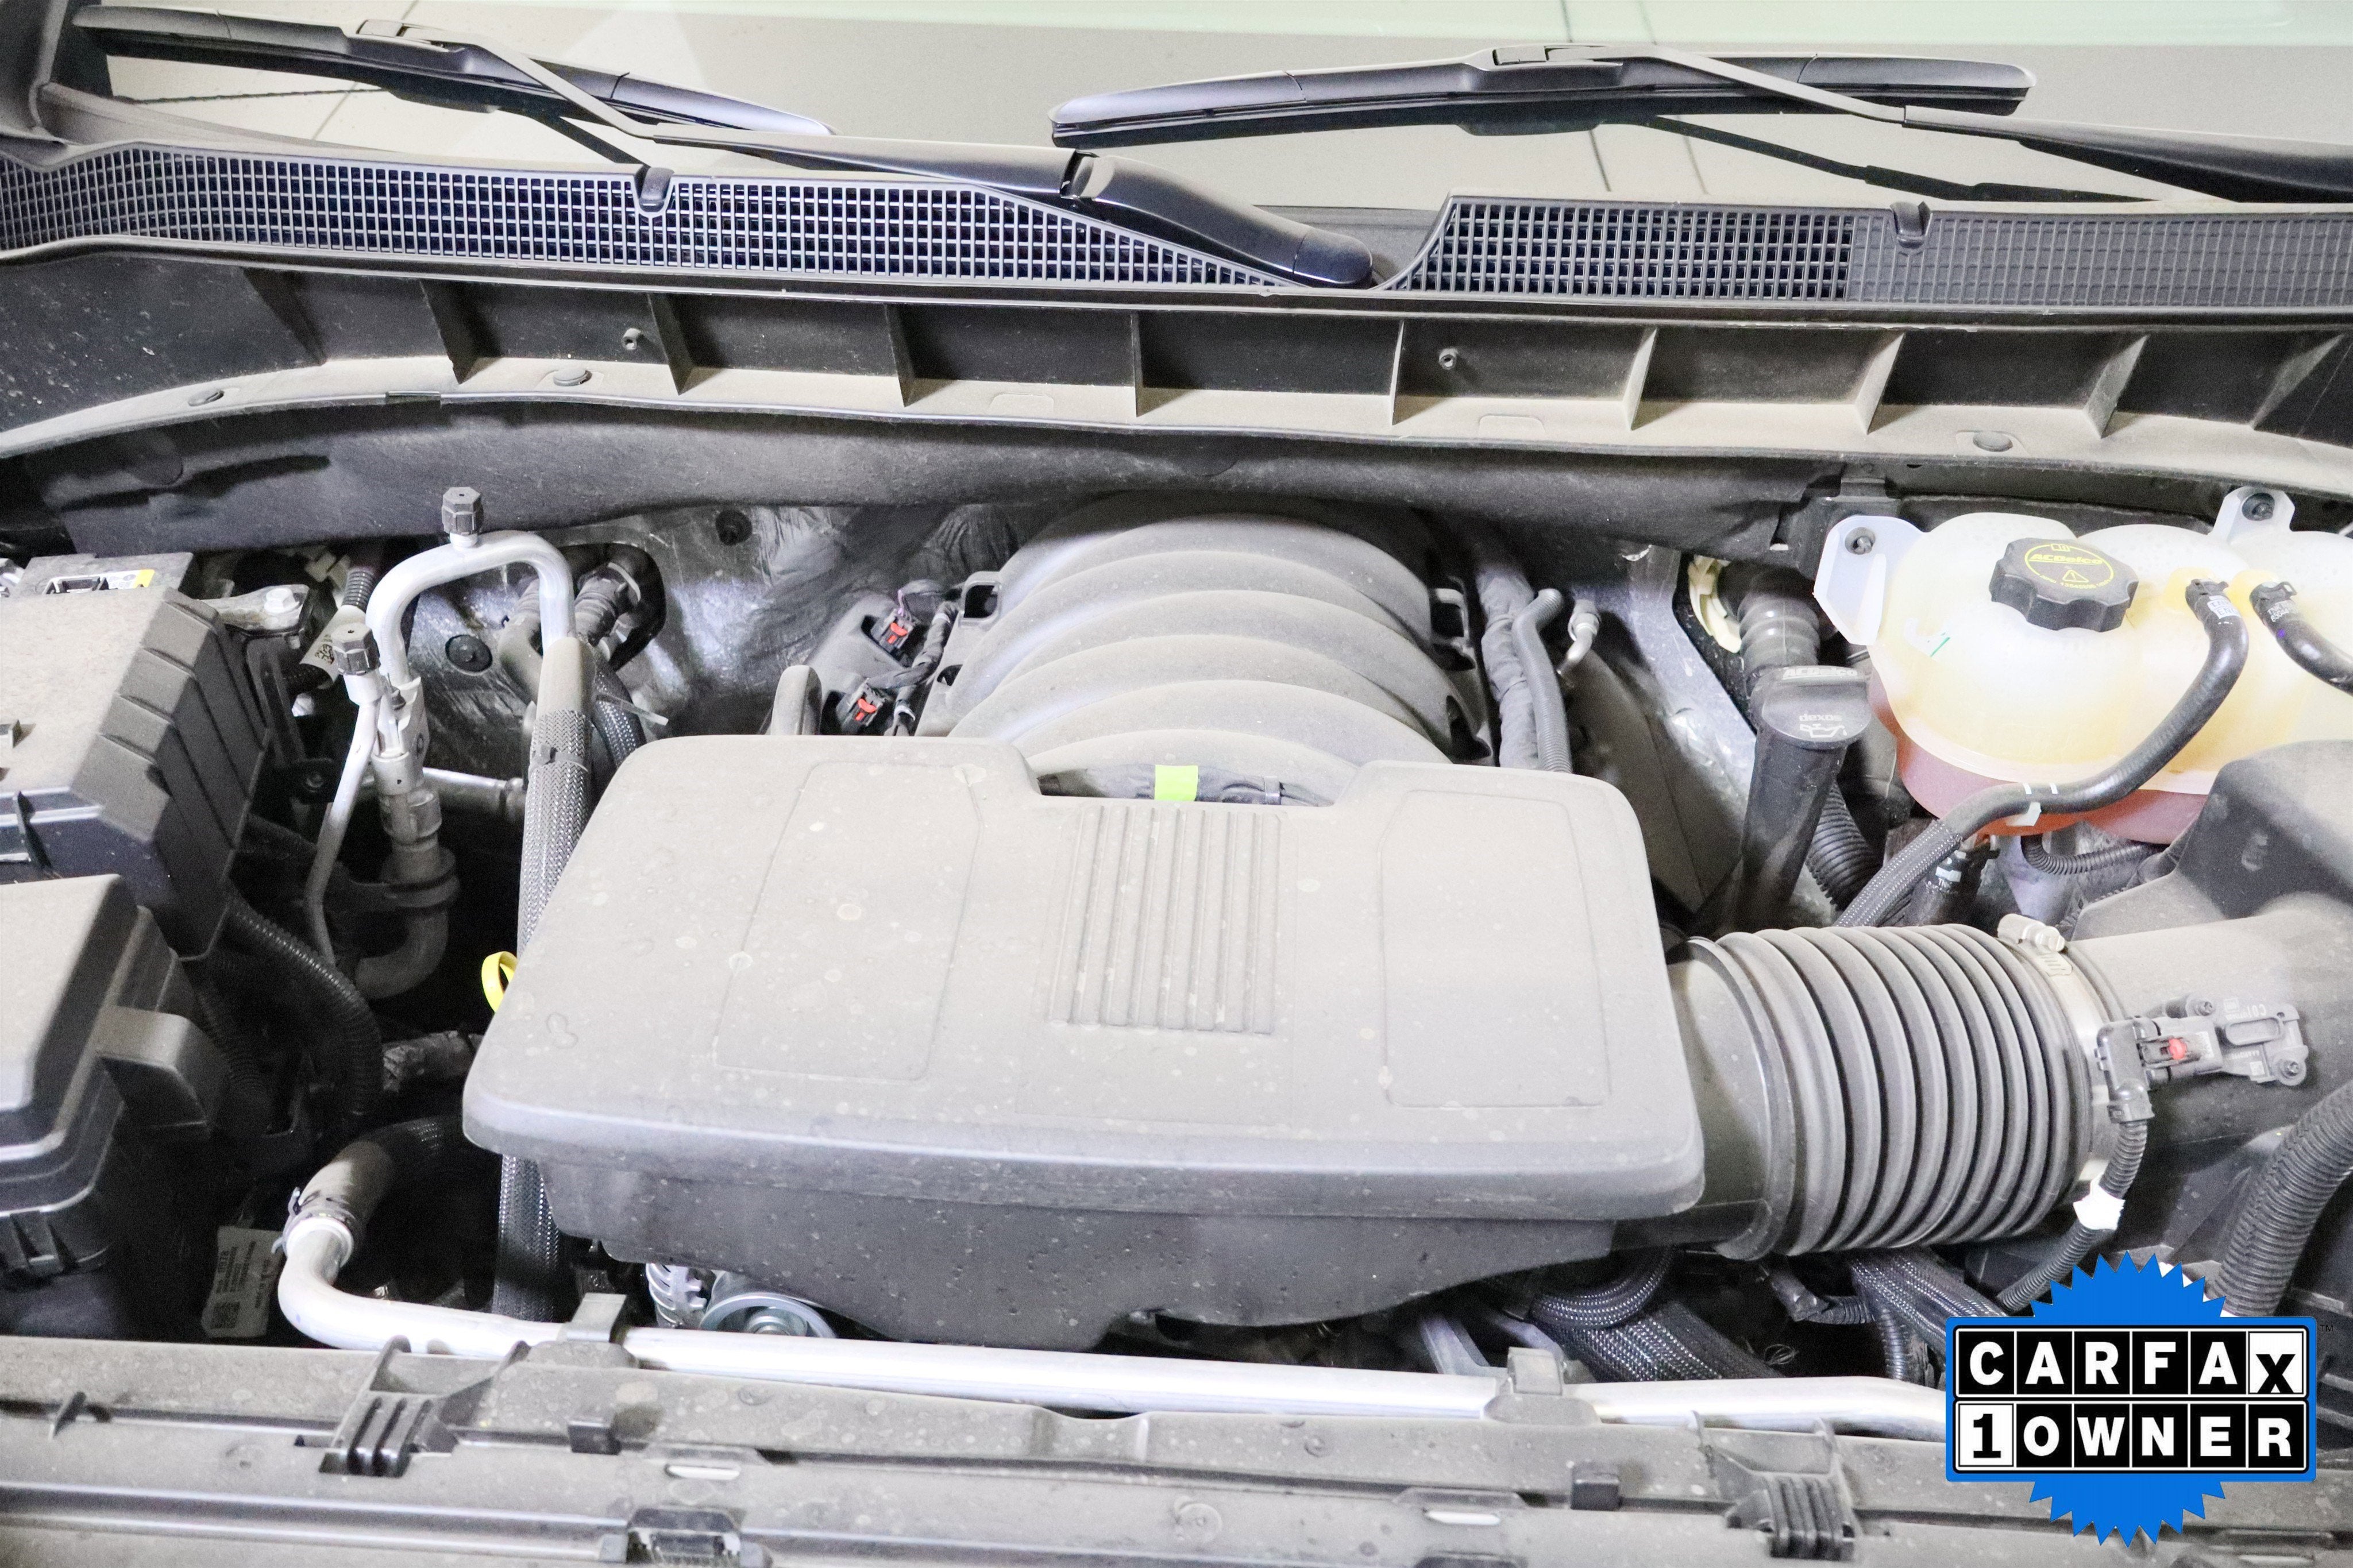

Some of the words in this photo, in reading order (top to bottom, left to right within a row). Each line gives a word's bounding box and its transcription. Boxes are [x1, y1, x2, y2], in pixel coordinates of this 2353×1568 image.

[2030, 554, 2103, 565] ACDelco
[1783, 667, 1858, 678] ACDelco
[1799, 713, 1842, 721] dexos
